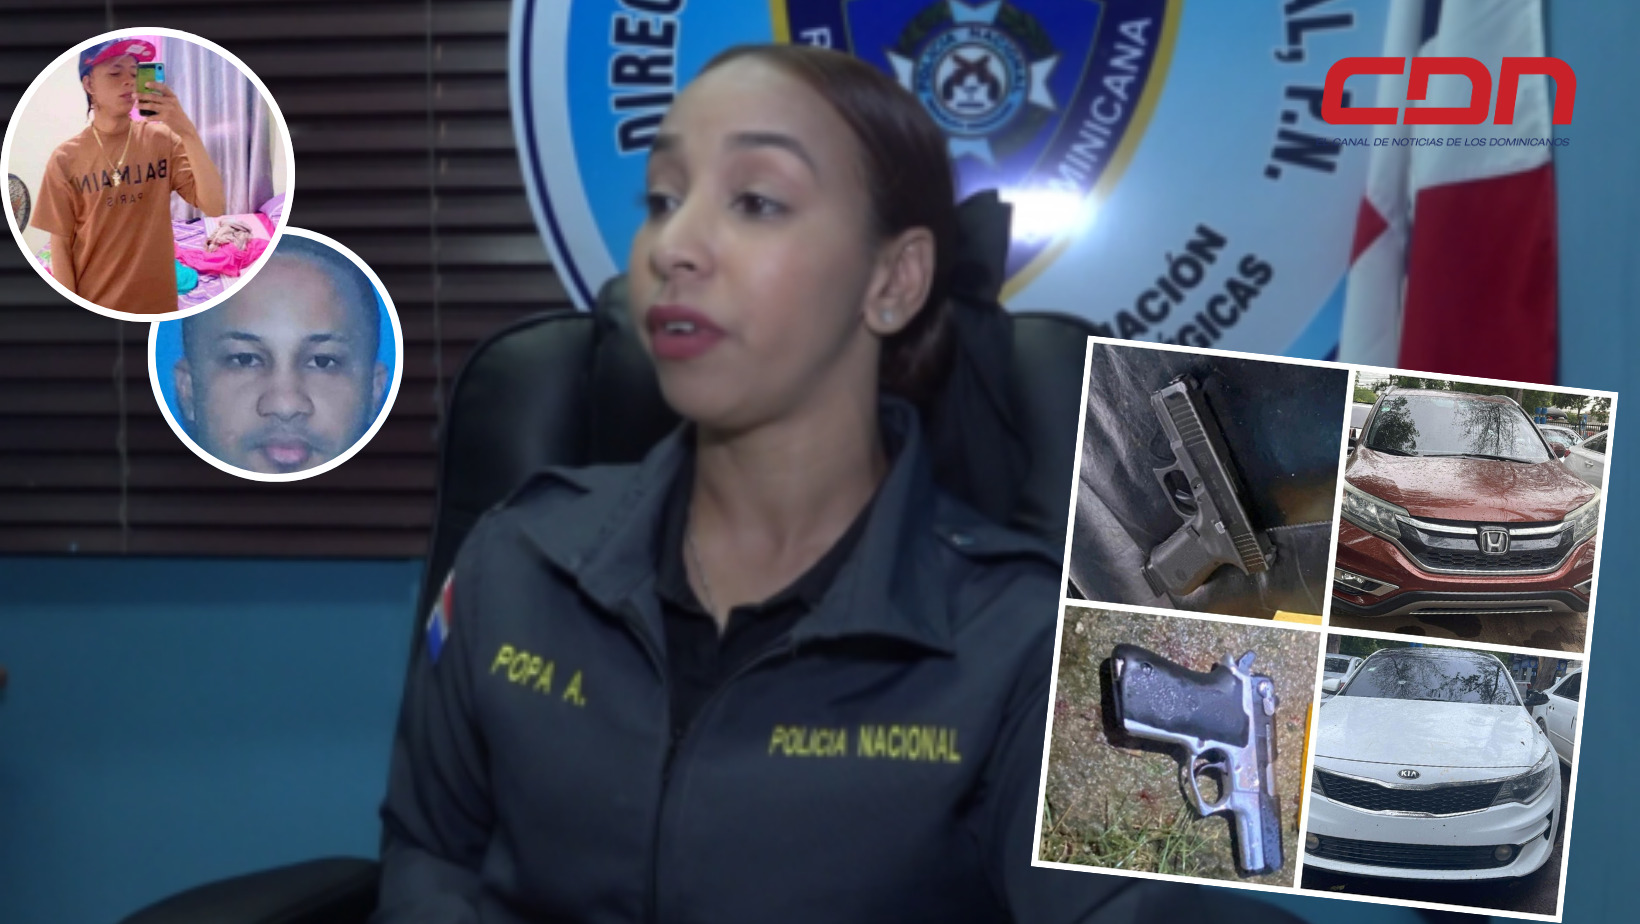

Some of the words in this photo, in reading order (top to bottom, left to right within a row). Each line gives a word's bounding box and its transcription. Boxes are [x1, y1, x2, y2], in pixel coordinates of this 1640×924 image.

[1158, 254, 1273, 348] GICAS
[490, 644, 554, 694] POPA
[563, 669, 586, 706] A.
[769, 724, 847, 757] POLICIA
[858, 724, 961, 763] NACIONAL
